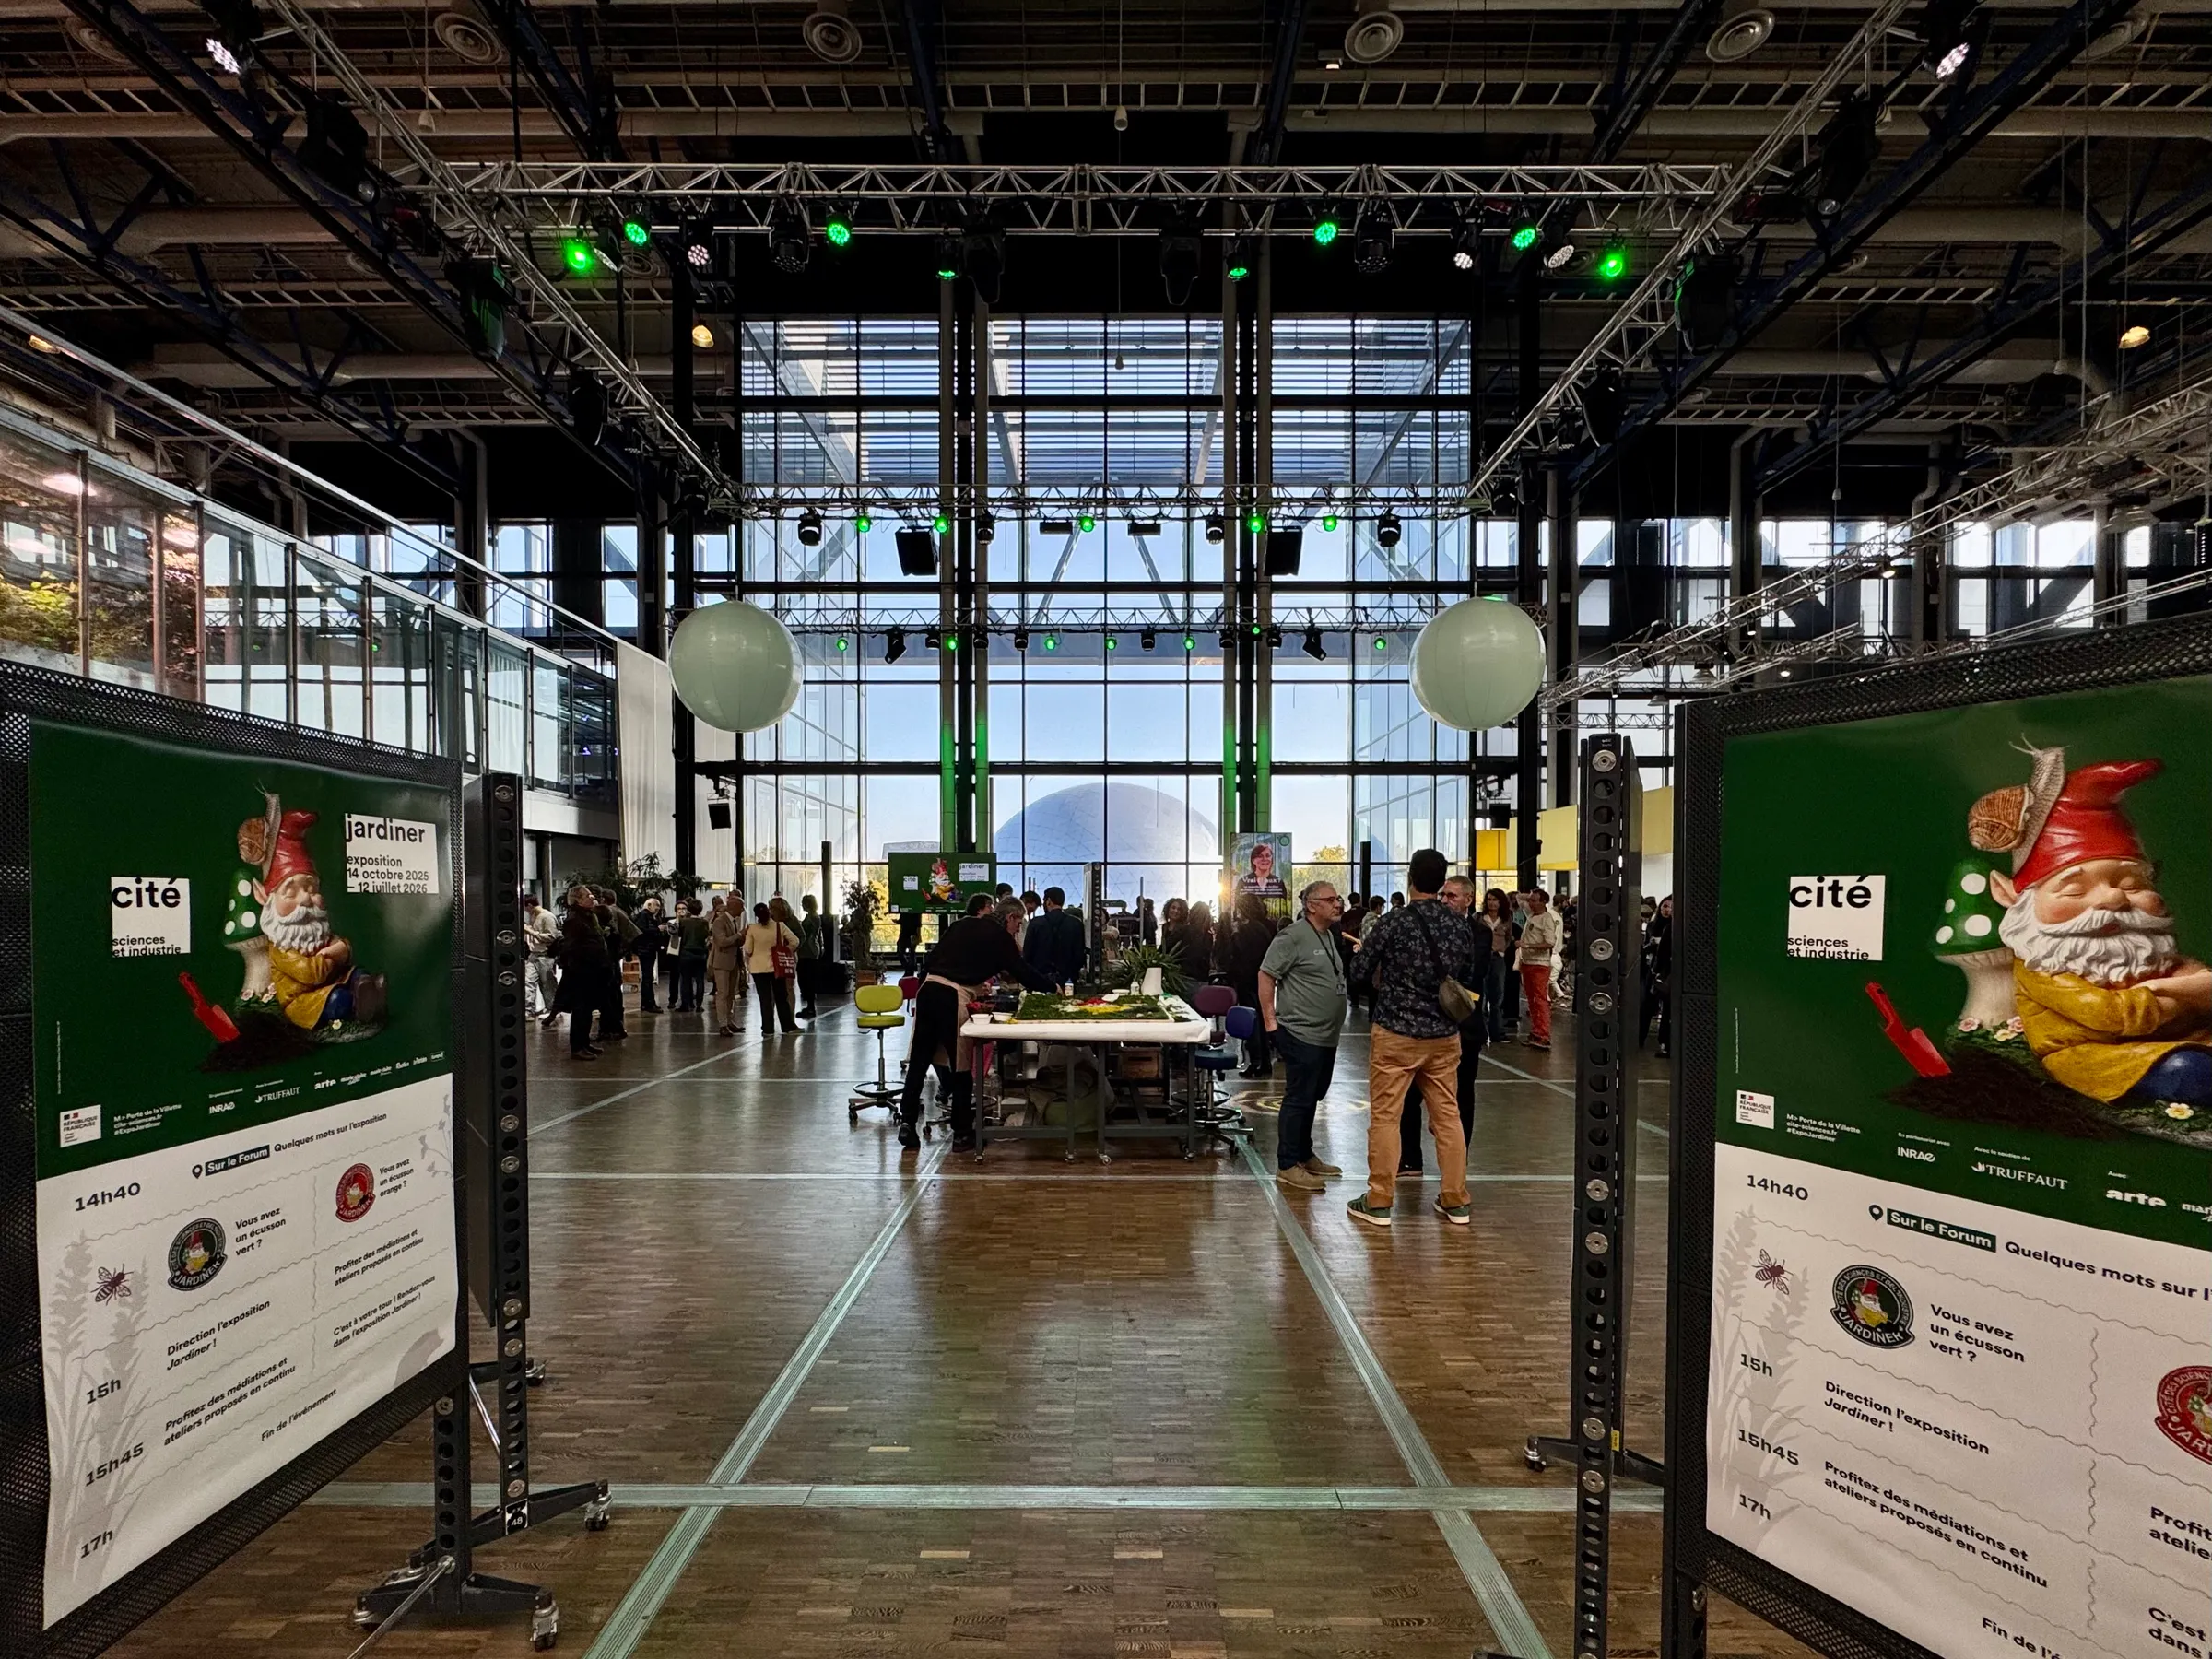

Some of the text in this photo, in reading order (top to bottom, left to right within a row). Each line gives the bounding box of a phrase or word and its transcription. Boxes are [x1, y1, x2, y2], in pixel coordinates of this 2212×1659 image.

[346, 814, 425, 842] jardiner
[347, 855, 402, 867] exposition
[347, 868, 429, 880] 14 octobre 2025
[112, 877, 181, 908] cité
[359, 882, 369, 893] 12
[372, 881, 401, 893] juillet
[404, 883, 428, 894] 2026
[1790, 876, 1871, 908] cité
[112, 935, 165, 946] sciences
[112, 944, 181, 957] et industrie
[1788, 935, 1848, 947] sciences
[1788, 947, 1869, 960] et industrie
[262, 1087, 300, 1102] TRUFFAUT
[314, 1079, 336, 1089] arte
[1740, 1100, 1771, 1110] RÉPUBLIQUE
[1740, 1105, 1769, 1114] FRANÇAISE
[1786, 1121, 1837, 1135] cite-sciences.fr
[1787, 1127, 1836, 1142] #ExpoJardiner
[1799, 1116, 1817, 1124] Porte
[1835, 1124, 1861, 1134] Villette
[207, 1112, 387, 1172] Sur le Forum Quelques mots sur l'exposition
[380, 1159, 410, 1174] Vous avez
[389, 1168, 414, 1182] écusson
[1986, 1164, 2068, 1189] TRUFFAUT
[75, 1182, 141, 1212] 14h40
[380, 1183, 402, 1197] orange
[1747, 1174, 1808, 1201] 14h40
[2106, 1189, 2212, 1216] arte mar
[235, 1208, 280, 1230] Vous avez
[235, 1218, 286, 1243] un écusson
[235, 1239, 263, 1256] vert ?
[335, 1256, 362, 1275] Profitez
[363, 1250, 375, 1261] des
[376, 1233, 410, 1254] médiations
[335, 1238, 424, 1286] ateliers proposés en continu
[1891, 1212, 1916, 1229] Sur
[1921, 1218, 1934, 1232] le
[1939, 1224, 1991, 1248] Forum
[2006, 1241, 2096, 1275] Quelques
[2102, 1266, 2155, 1288] mots
[2161, 1282, 2197, 1298] sur
[334, 1321, 352, 1335] C'est
[359, 1308, 377, 1322] votre
[379, 1300, 393, 1311] tour
[396, 1276, 435, 1300] Rendez-vous
[167, 1300, 270, 1356] Direction l'exposition
[333, 1334, 350, 1348] dans
[352, 1311, 390, 1337] l'exposition
[392, 1295, 418, 1314] Jardiner
[1930, 1304, 2014, 1341] Vous avez
[167, 1341, 211, 1371] Jardiner
[1930, 1324, 2025, 1362] un écusson
[1930, 1340, 1977, 1362] vert ?
[1740, 1353, 1773, 1377] 15h
[86, 1378, 121, 1405] 15h
[164, 1365, 296, 1446] ateliers proposés en continu
[165, 1357, 288, 1431] Profitez des médiations et
[262, 1388, 336, 1441] Fin de l'événement
[1824, 1398, 1893, 1432] Jardiner !
[1825, 1381, 1989, 1454] Direction l'exposition
[1738, 1428, 1799, 1465] 15h45
[85, 1442, 144, 1487] 15h45
[1739, 1494, 1771, 1520] 17h
[1824, 1461, 2028, 1562] Profitez des médiations et
[1824, 1477, 2048, 1588] ateliers proposés en continu
[2150, 1506, 2212, 1542] Profit
[80, 1529, 113, 1559] 17h
[2149, 1528, 2212, 1560] atelie
[1983, 1617, 2007, 1639] Fin
[2013, 1635, 2036, 1653] de
[2148, 1607, 2207, 1642] C'est
[2148, 1628, 2202, 1659] dans
